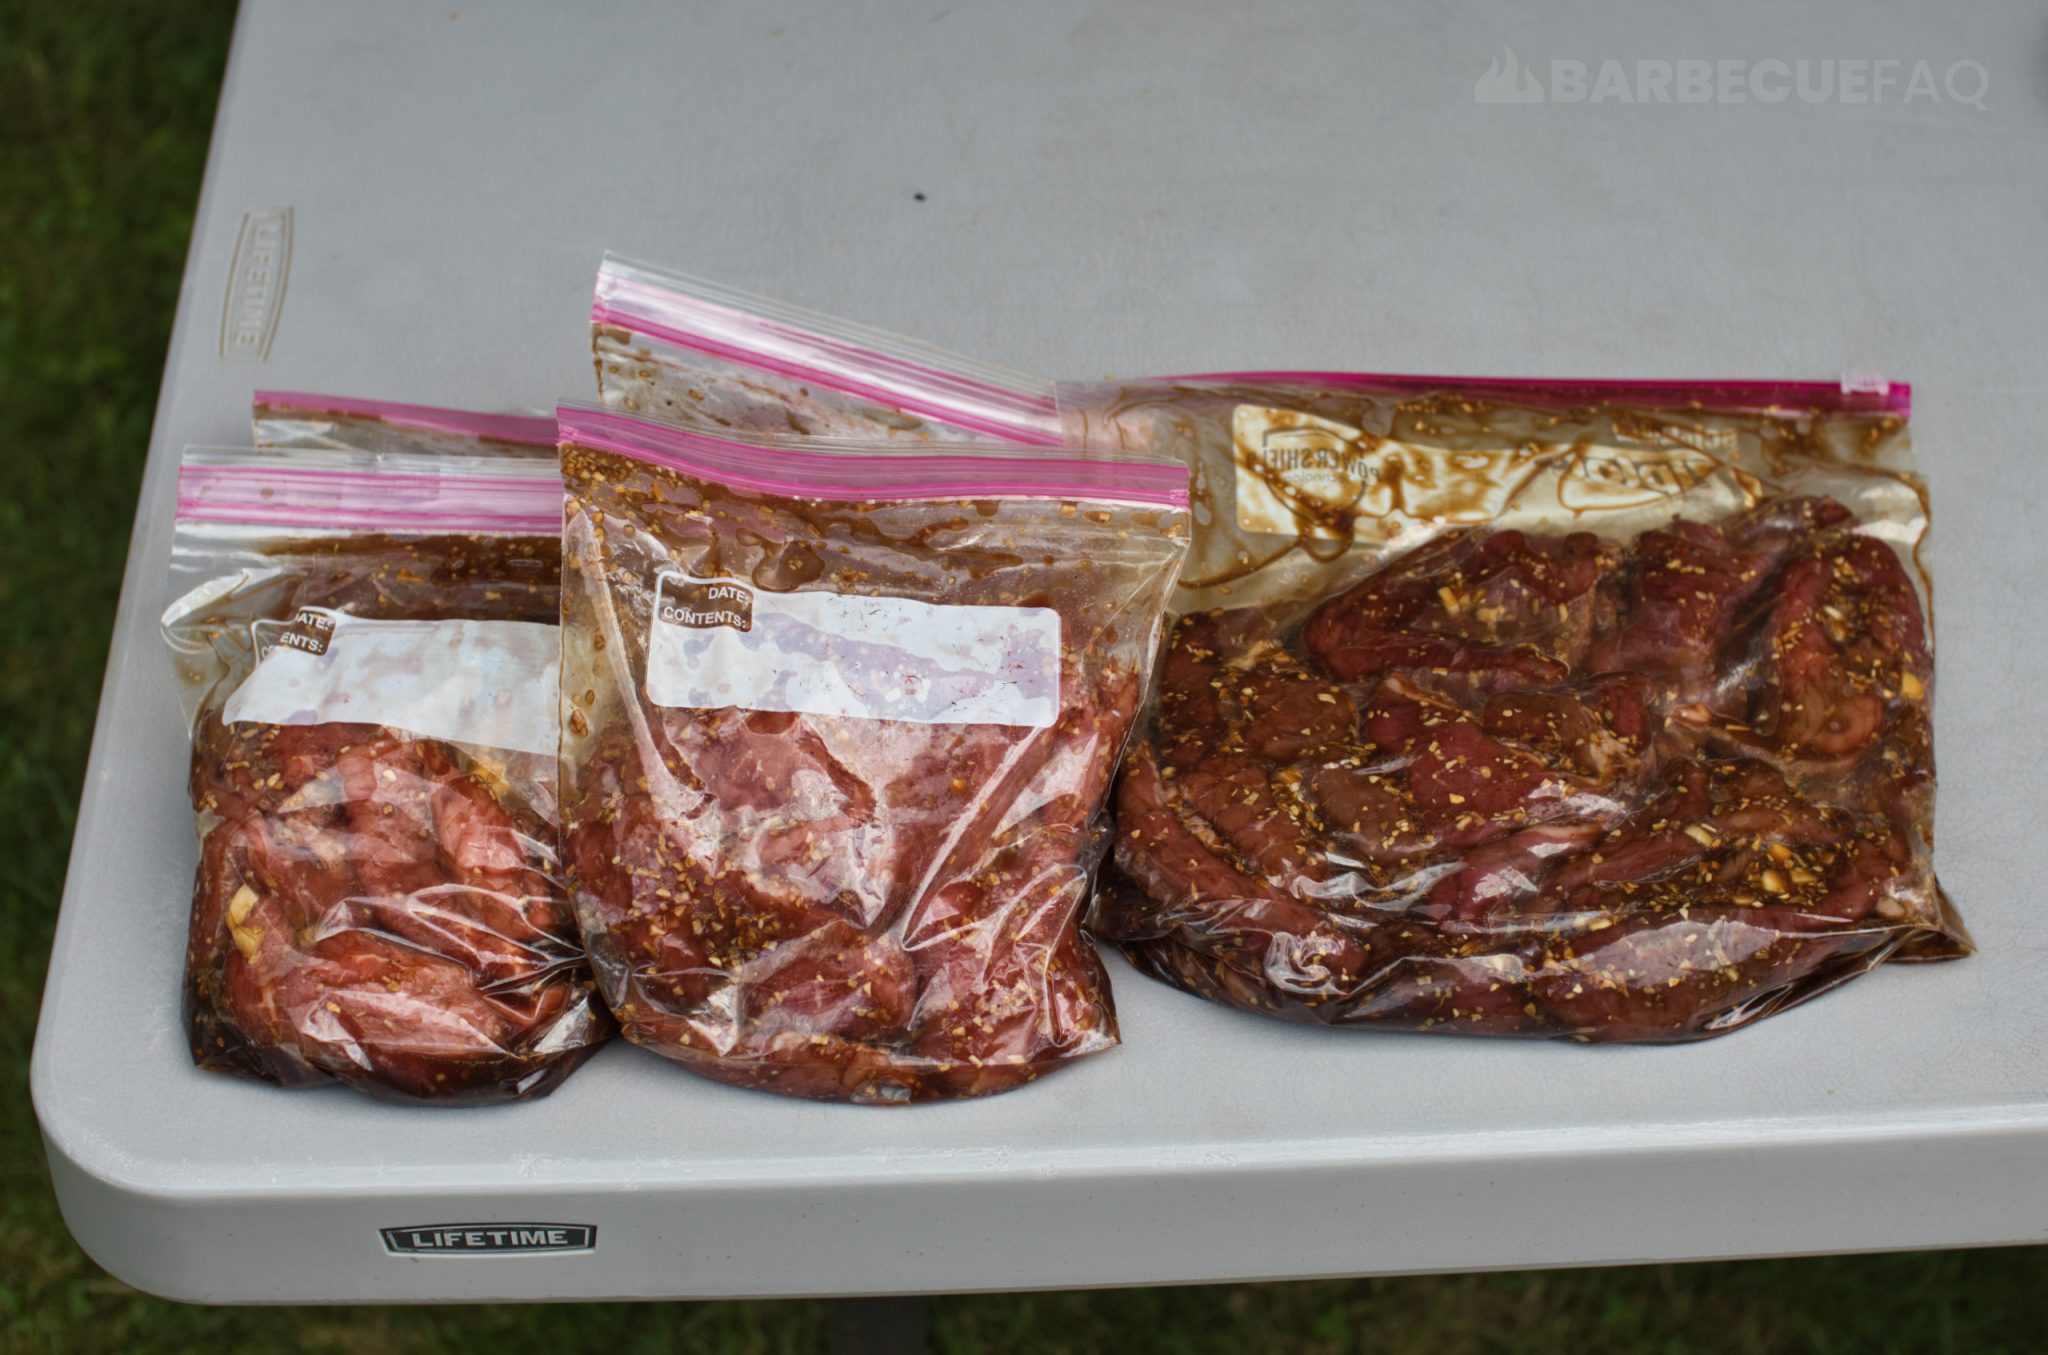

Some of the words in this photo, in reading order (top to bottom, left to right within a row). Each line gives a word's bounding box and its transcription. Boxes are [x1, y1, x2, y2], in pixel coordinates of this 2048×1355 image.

[234, 214, 277, 347] LIFETIME
[295, 612, 330, 631] ATE:
[663, 606, 748, 629] CONTENTS:
[412, 1230, 569, 1247] LIFETIME
